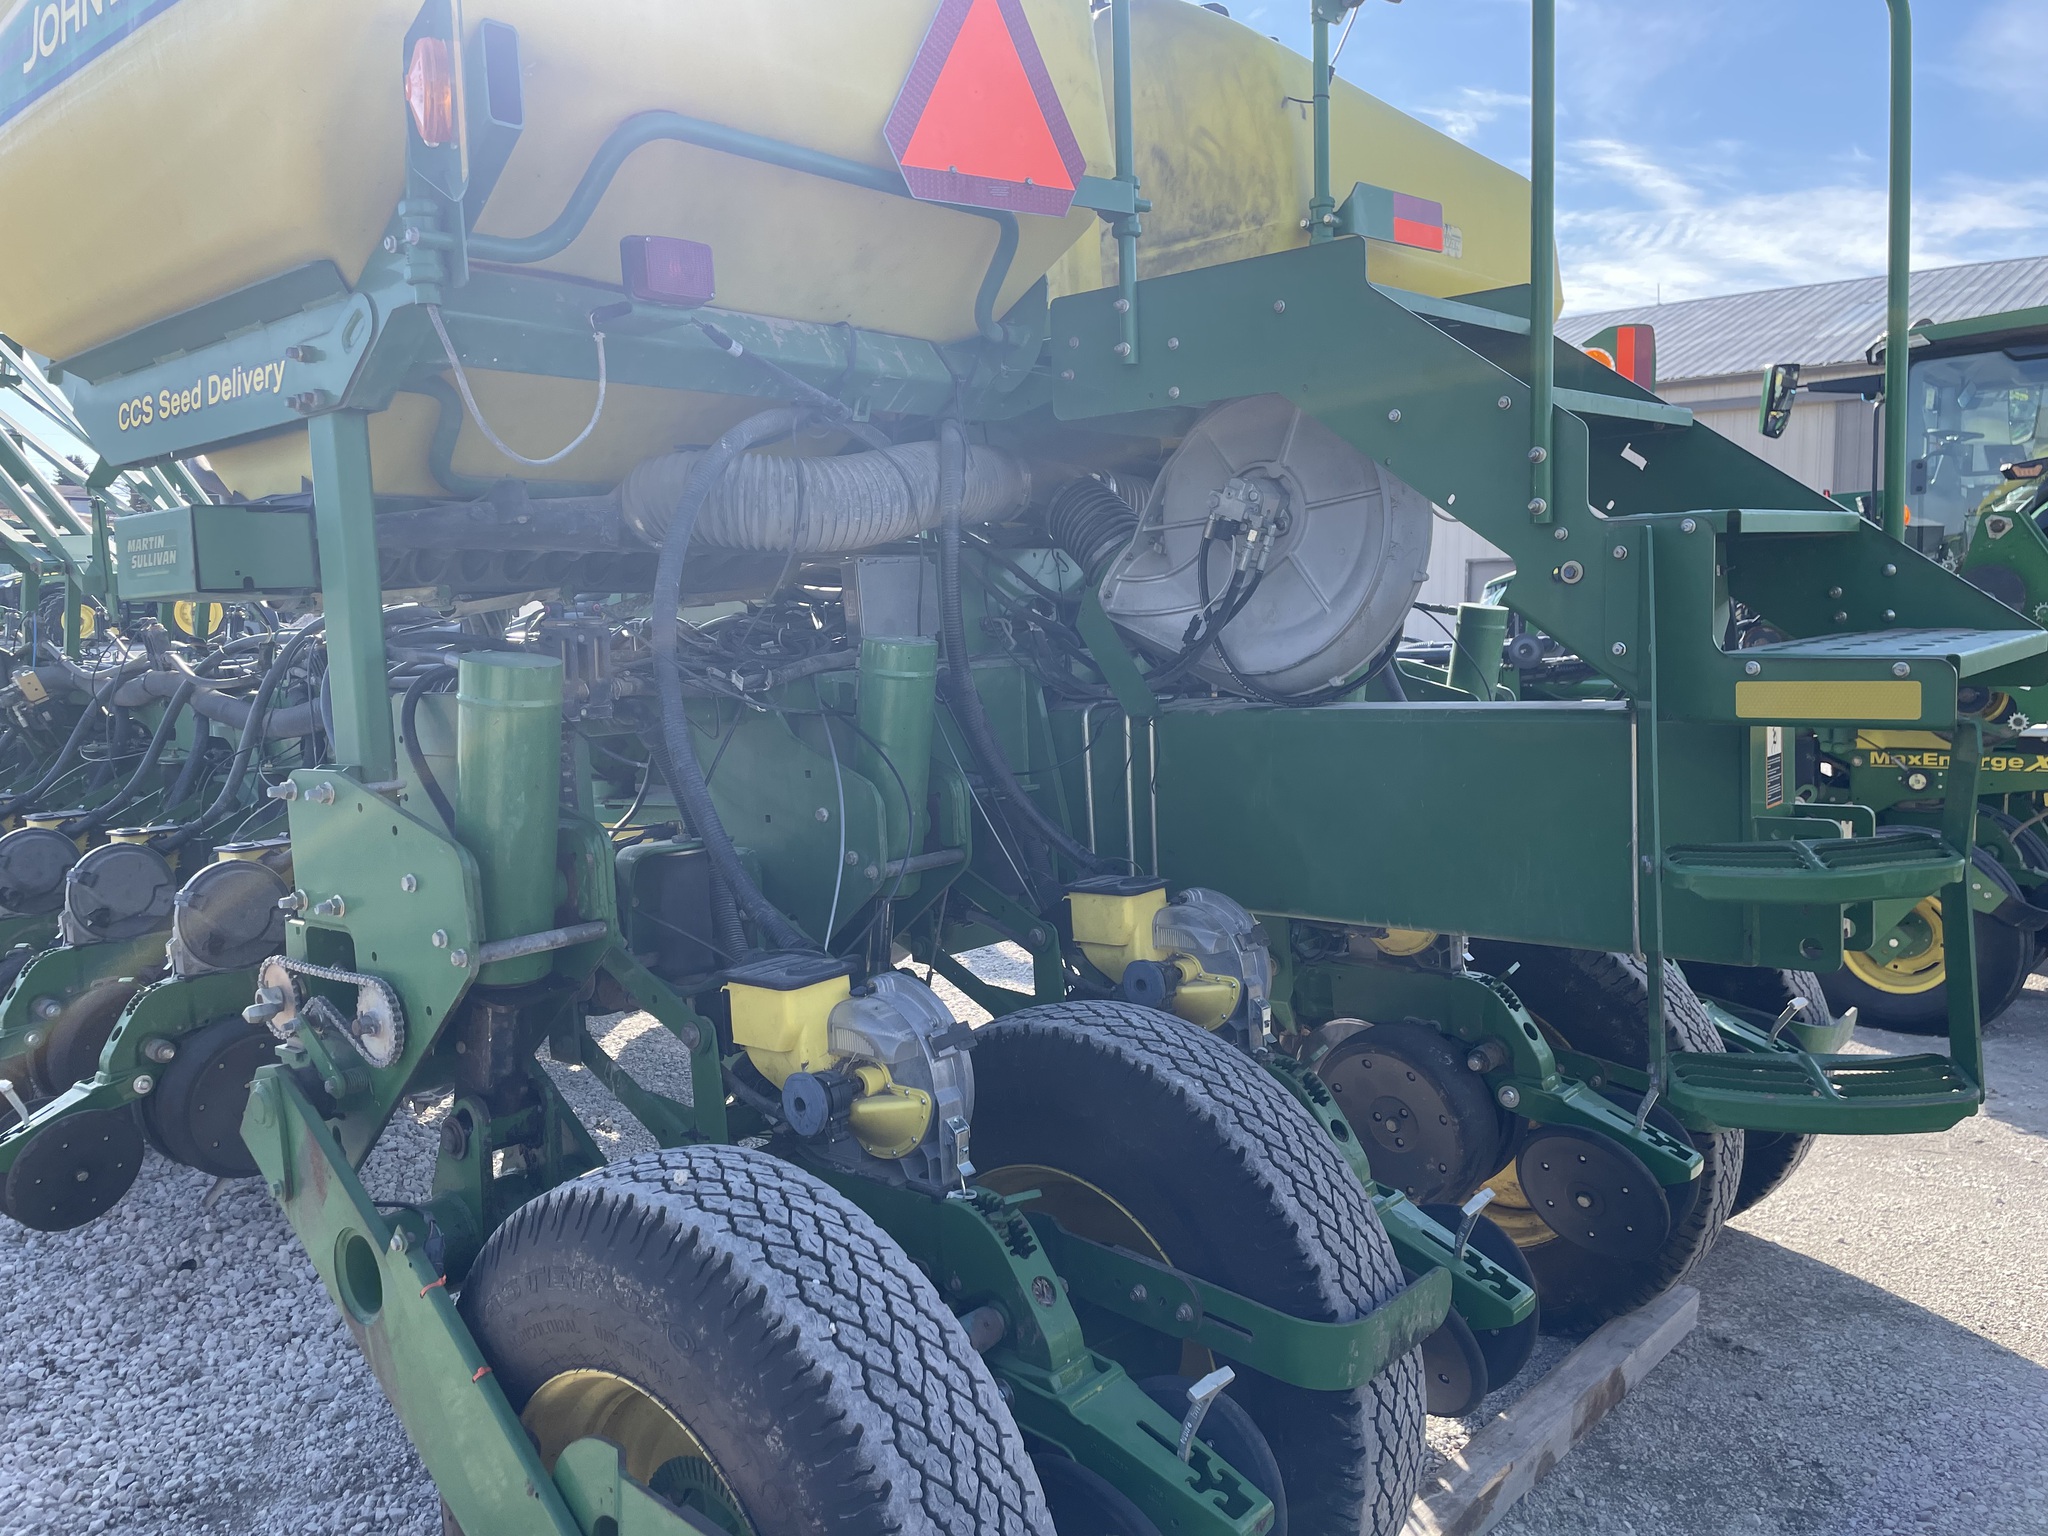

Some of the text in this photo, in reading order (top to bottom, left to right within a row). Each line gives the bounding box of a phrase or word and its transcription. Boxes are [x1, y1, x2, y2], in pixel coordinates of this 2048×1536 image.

[118, 360, 286, 431] CCS Seed Delivery
[127, 535, 165, 553] MARTIN
[131, 550, 176, 569] SULLIVAN
